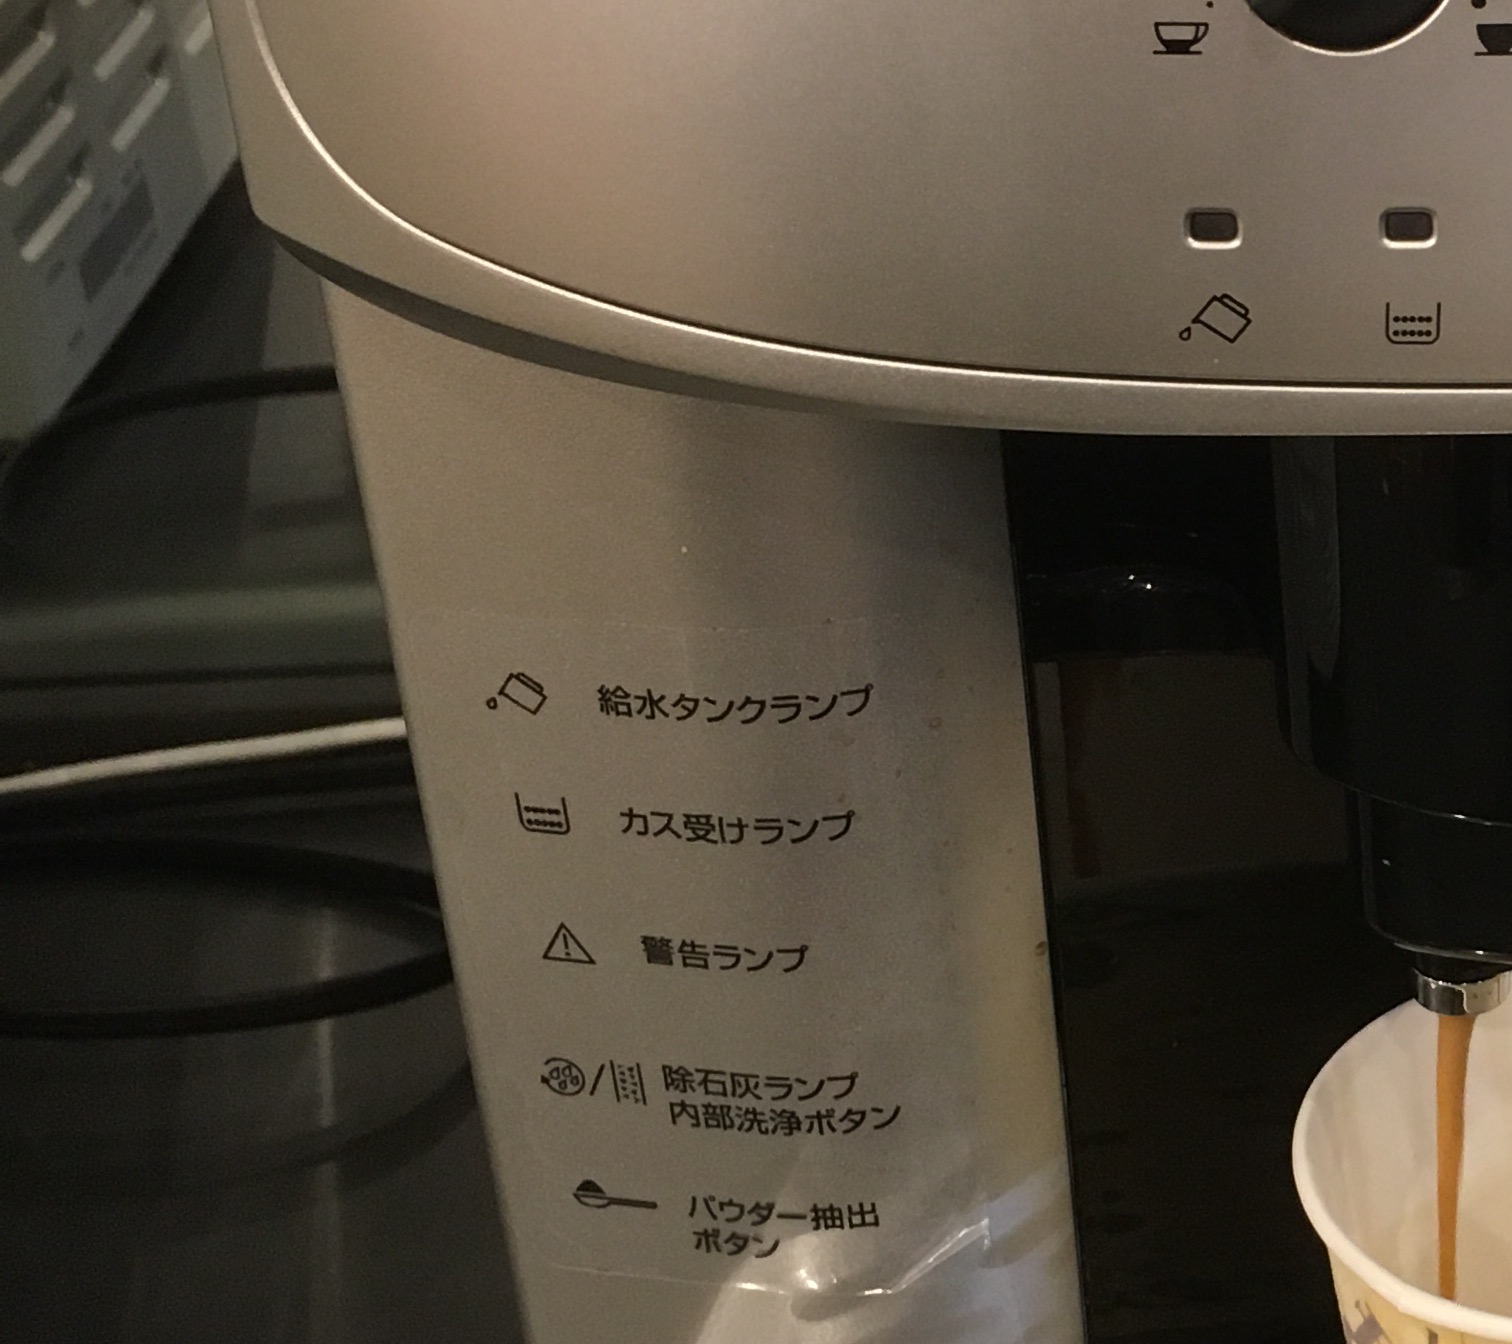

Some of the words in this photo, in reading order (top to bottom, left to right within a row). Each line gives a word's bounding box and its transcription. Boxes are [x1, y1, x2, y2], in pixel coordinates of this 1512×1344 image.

[597, 683, 874, 725] 給水タンクランプ
[619, 809, 856, 845] カス受けランプ
[640, 935, 810, 973] 警告ランプ
[661, 1064, 859, 1102] 除石灰ランプ
[669, 1102, 902, 1137] 内部洗浄ボタン
[688, 1195, 880, 1231] パウダー抽出
[692, 1229, 781, 1259] ボタン
